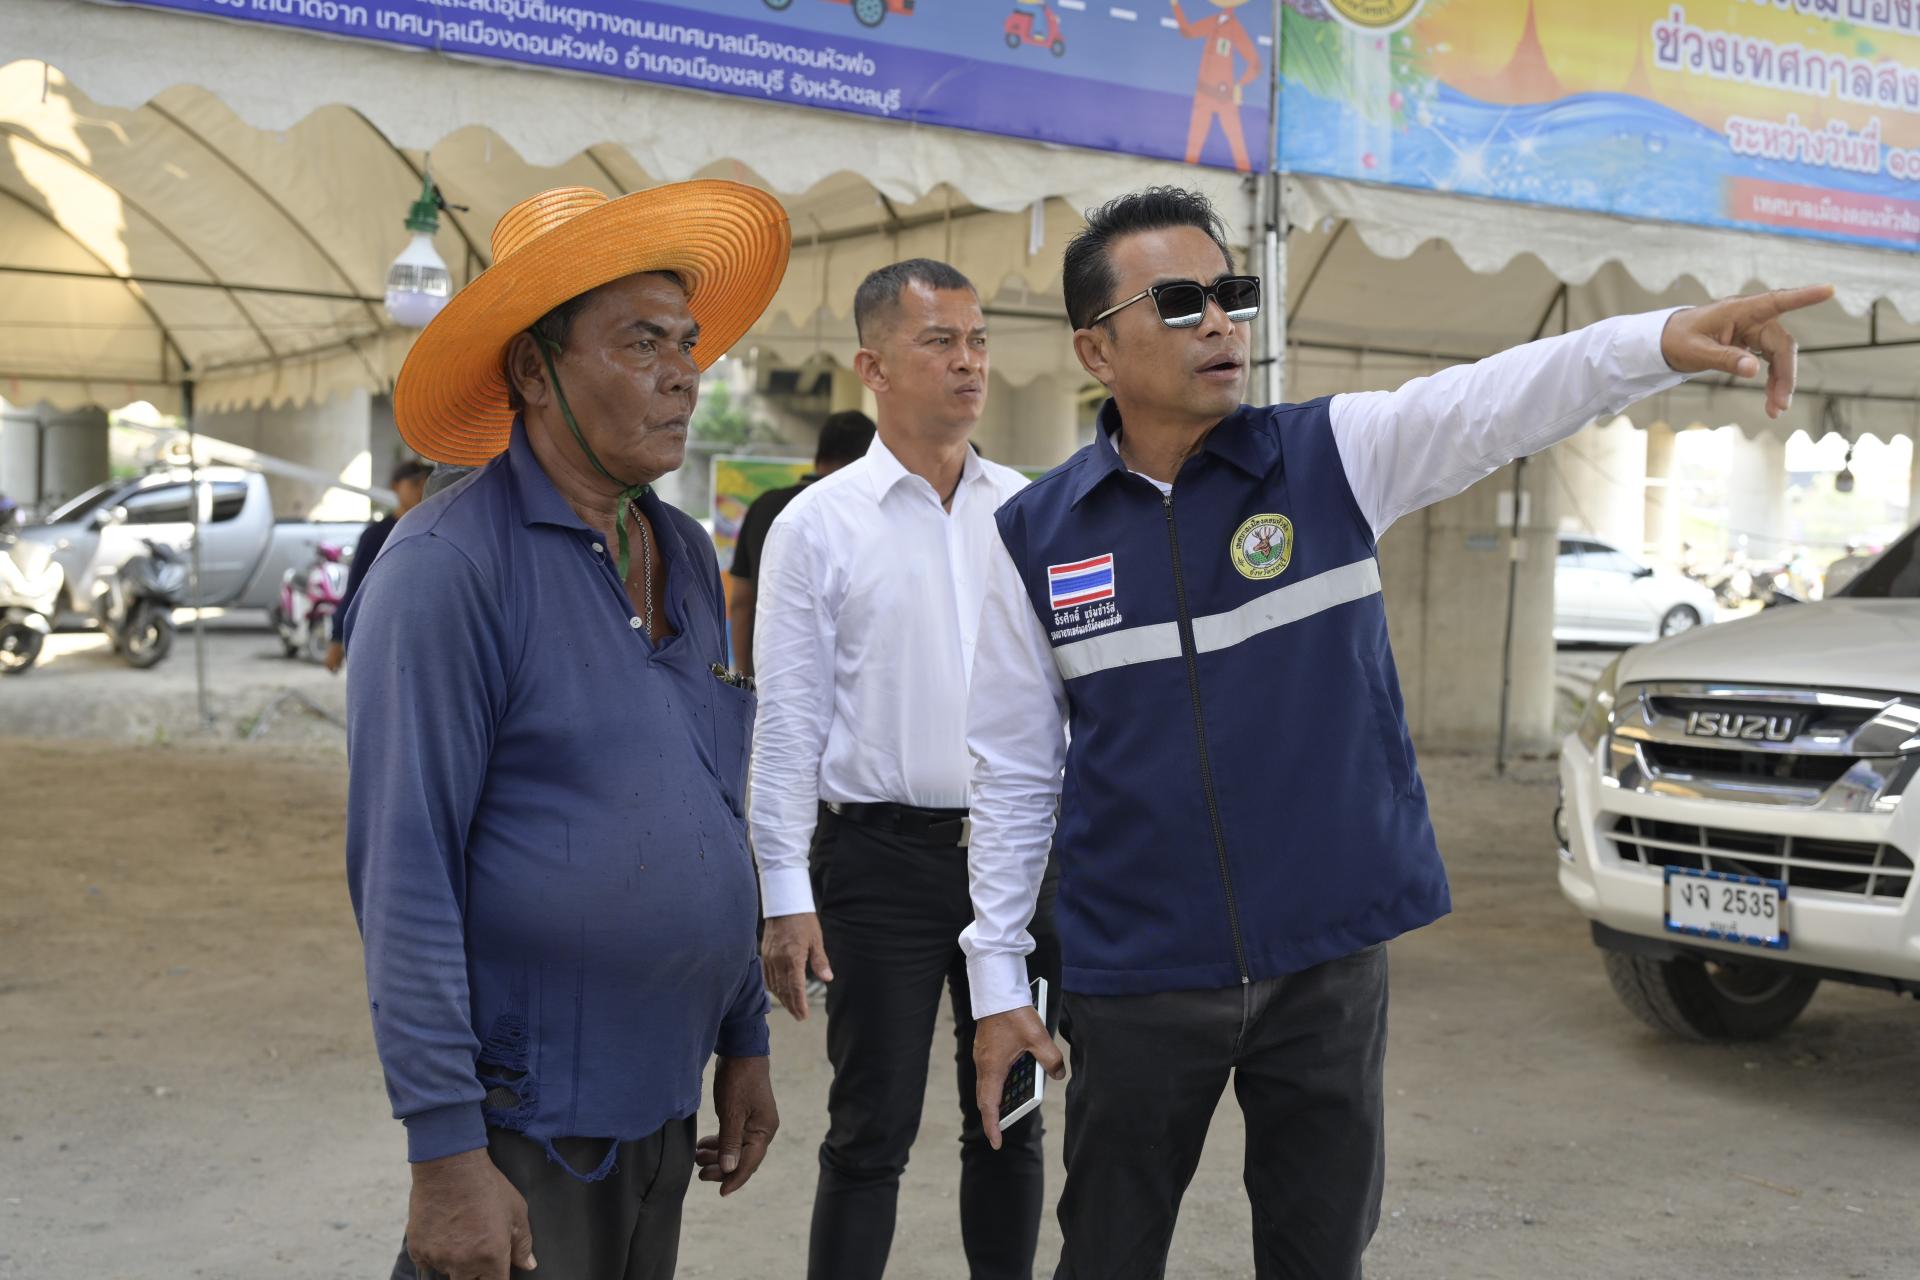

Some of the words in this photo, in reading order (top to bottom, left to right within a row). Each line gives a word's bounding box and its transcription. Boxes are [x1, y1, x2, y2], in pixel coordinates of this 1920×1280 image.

[624, 46, 785, 95] อำเภอเมืองชลบุรี
[790, 72, 901, 115] จังหวัดชลบุรี
[1726, 114, 1881, 173] ระหว่างวันที่
[1054, 606, 1080, 626] ธีรศักดิ์
[1687, 711, 1792, 741] ISUZU
[1722, 887, 1775, 918] 2535
